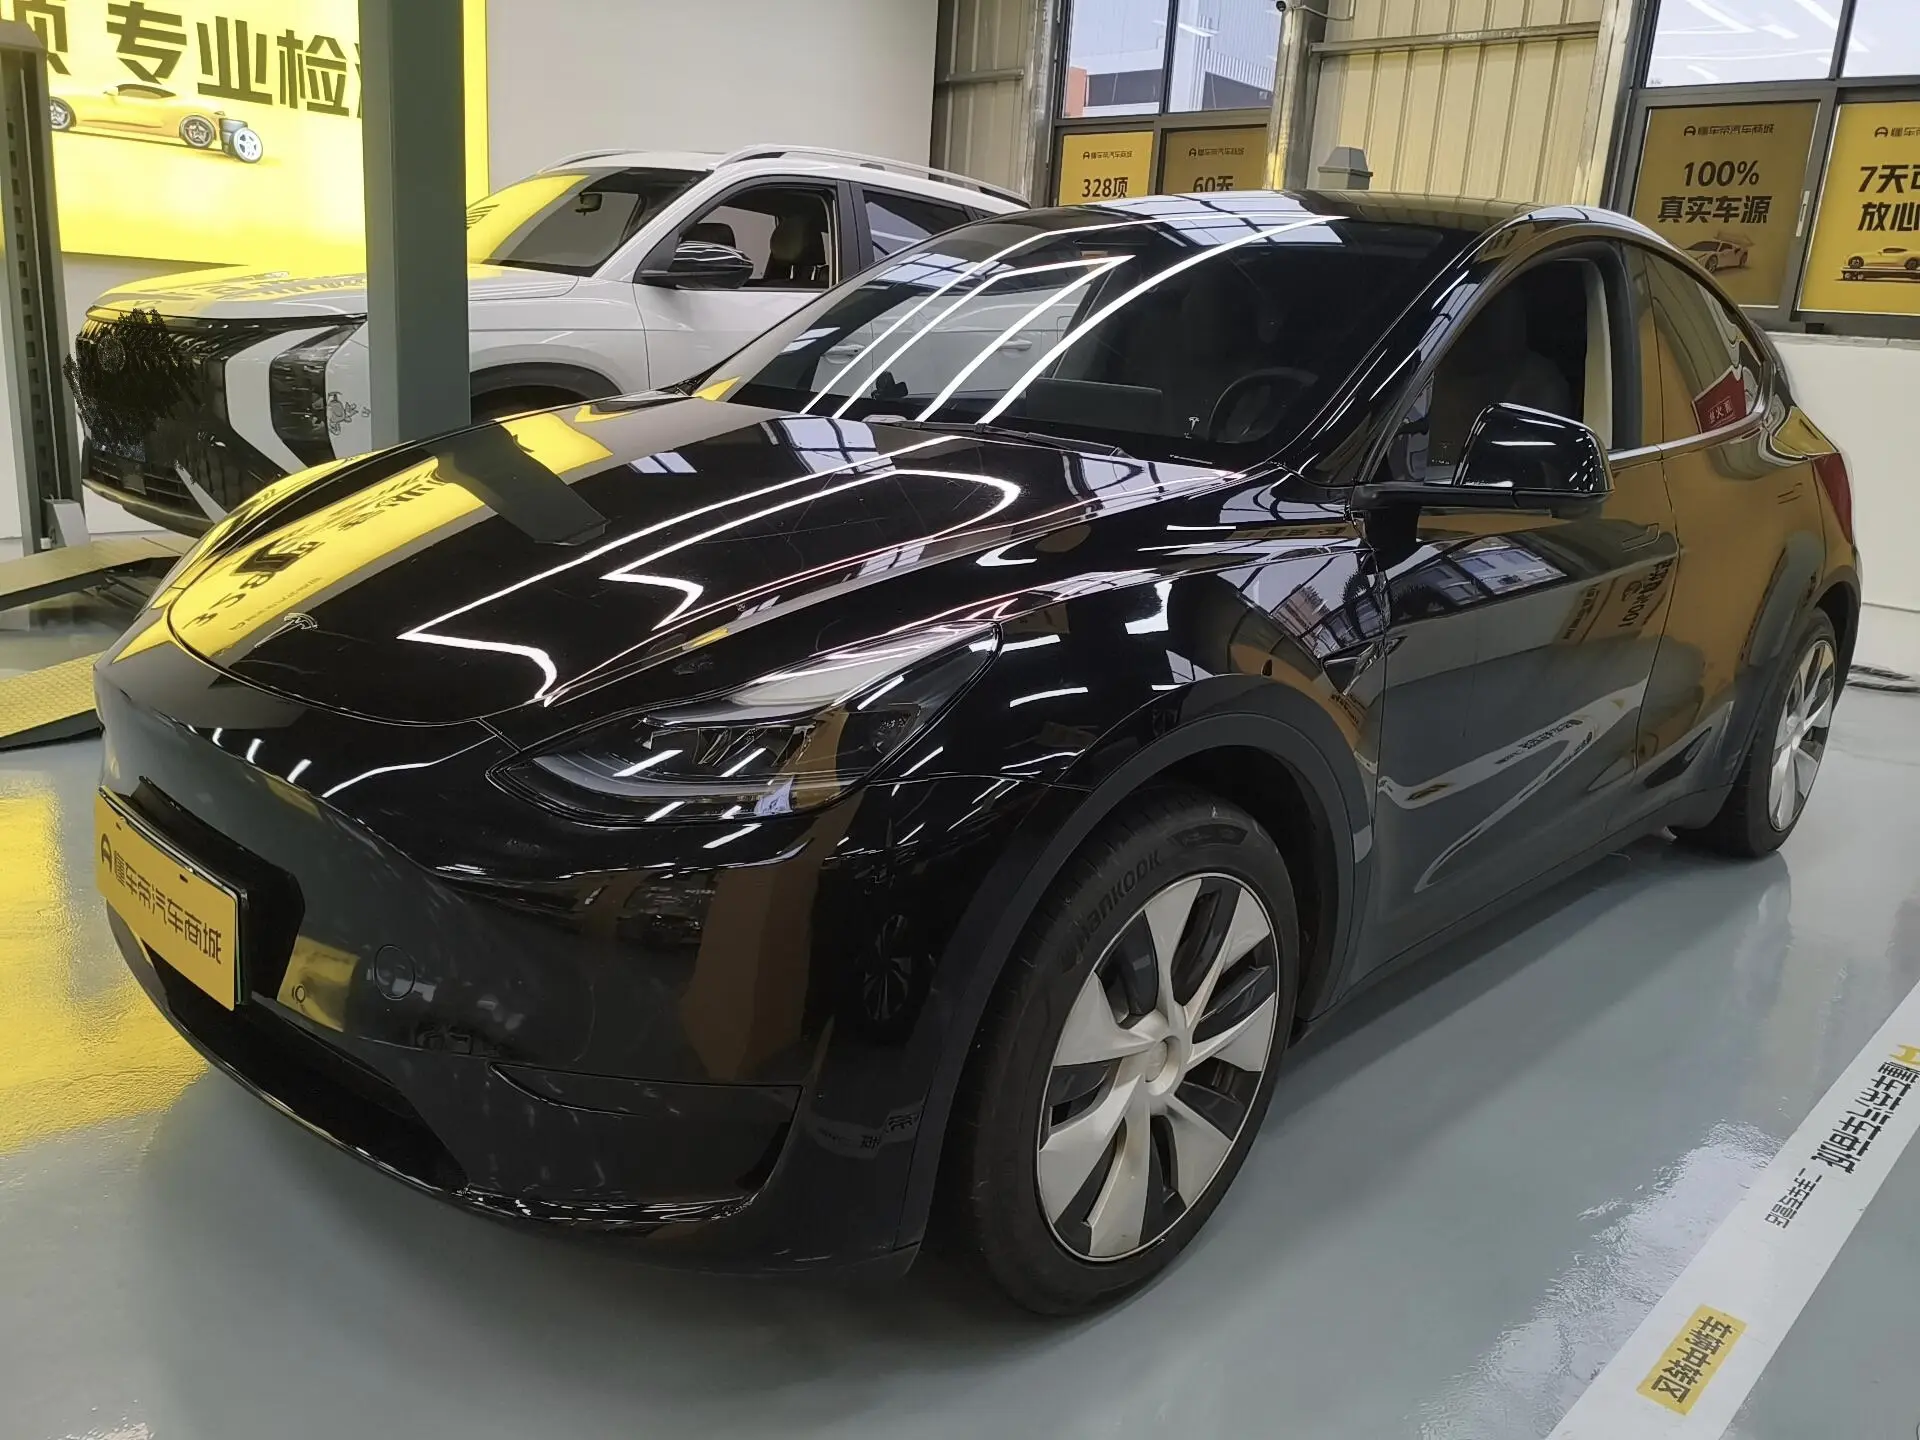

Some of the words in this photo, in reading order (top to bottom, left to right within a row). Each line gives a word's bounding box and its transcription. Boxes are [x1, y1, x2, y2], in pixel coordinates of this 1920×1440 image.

[106, 1, 361, 119] 专业检
[1082, 177, 1129, 198] 328项
[1657, 195, 1773, 224] 真实车源
[1683, 160, 1760, 187] 100%
[113, 850, 222, 965] 懂车帝汽车商城
[1810, 1061, 1920, 1174] 懂车帝汽车商城
[1651, 1315, 1732, 1403] 车辆中转区
